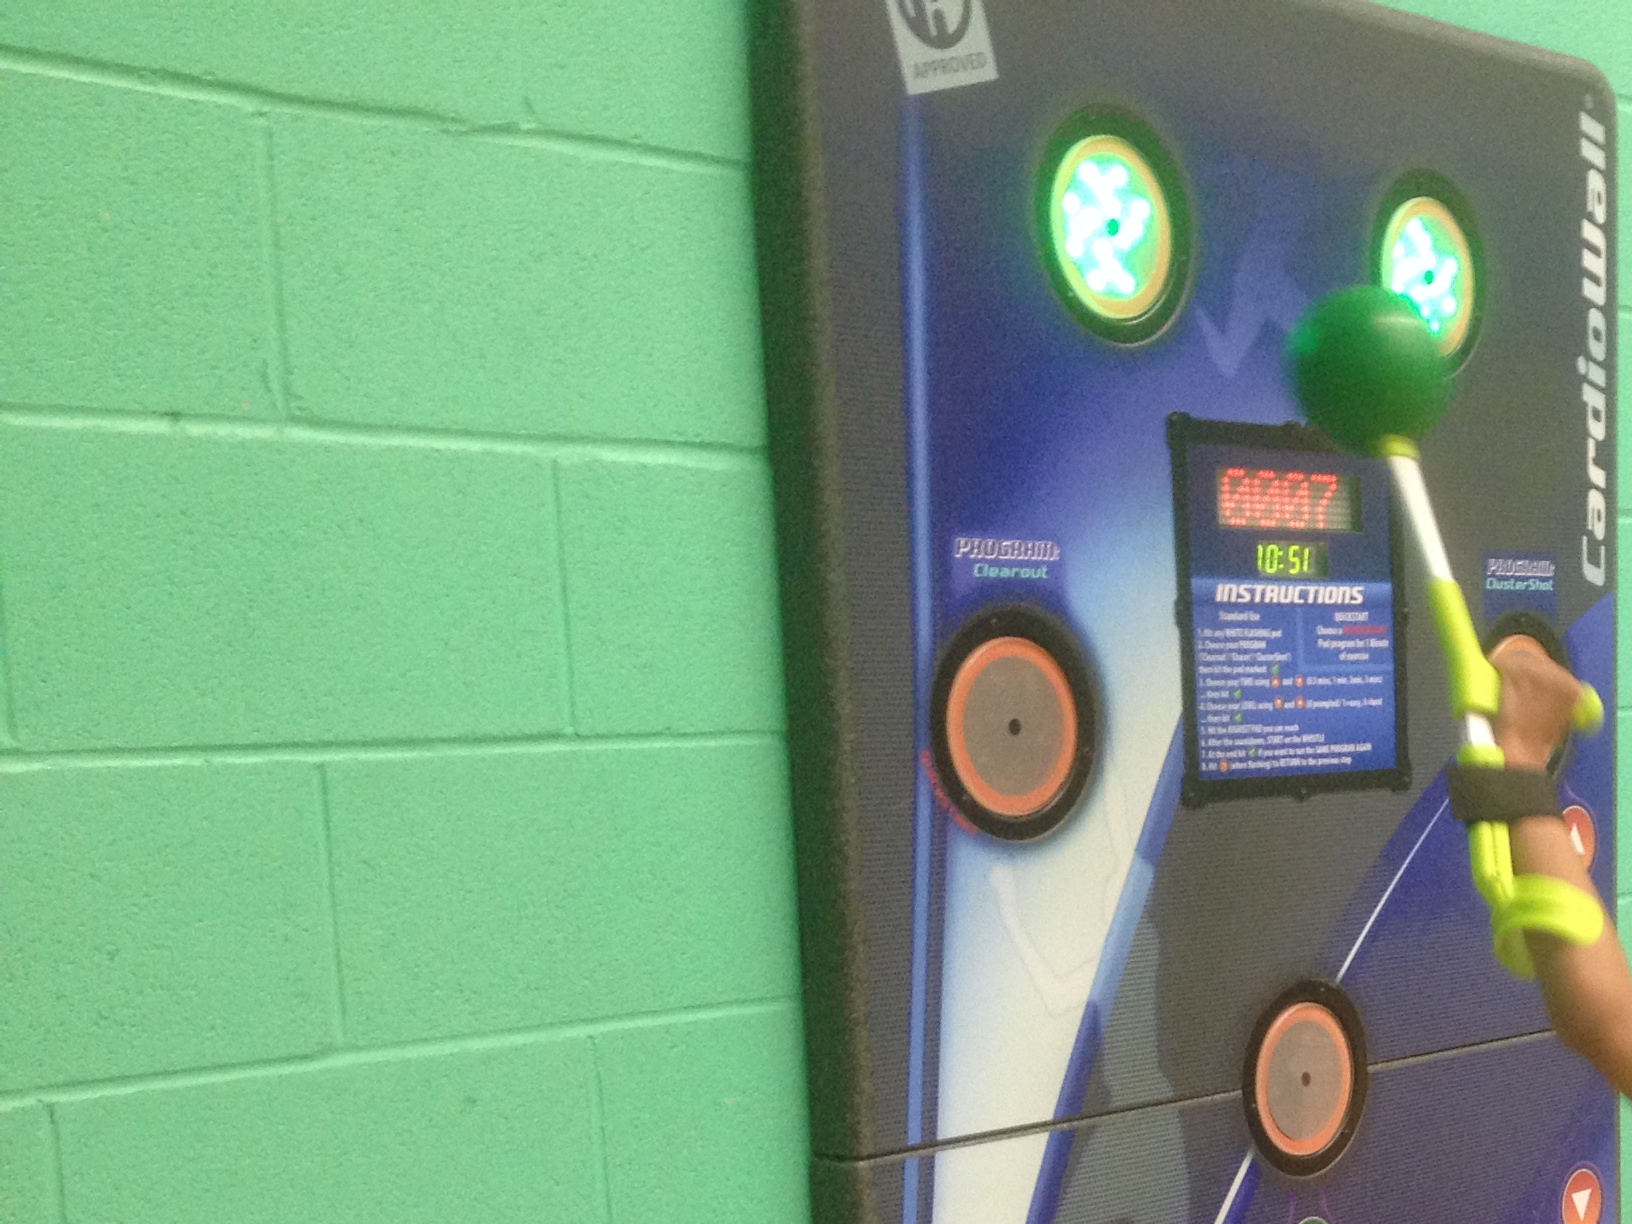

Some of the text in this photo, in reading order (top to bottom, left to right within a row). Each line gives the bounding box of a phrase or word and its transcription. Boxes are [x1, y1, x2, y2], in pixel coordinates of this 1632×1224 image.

[1257, 544, 1309, 574] 10:51
[973, 563, 1048, 578] Clearout
[1486, 577, 1554, 591] ClusterShot
[1215, 583, 1364, 604] INSTRUCTIONS
